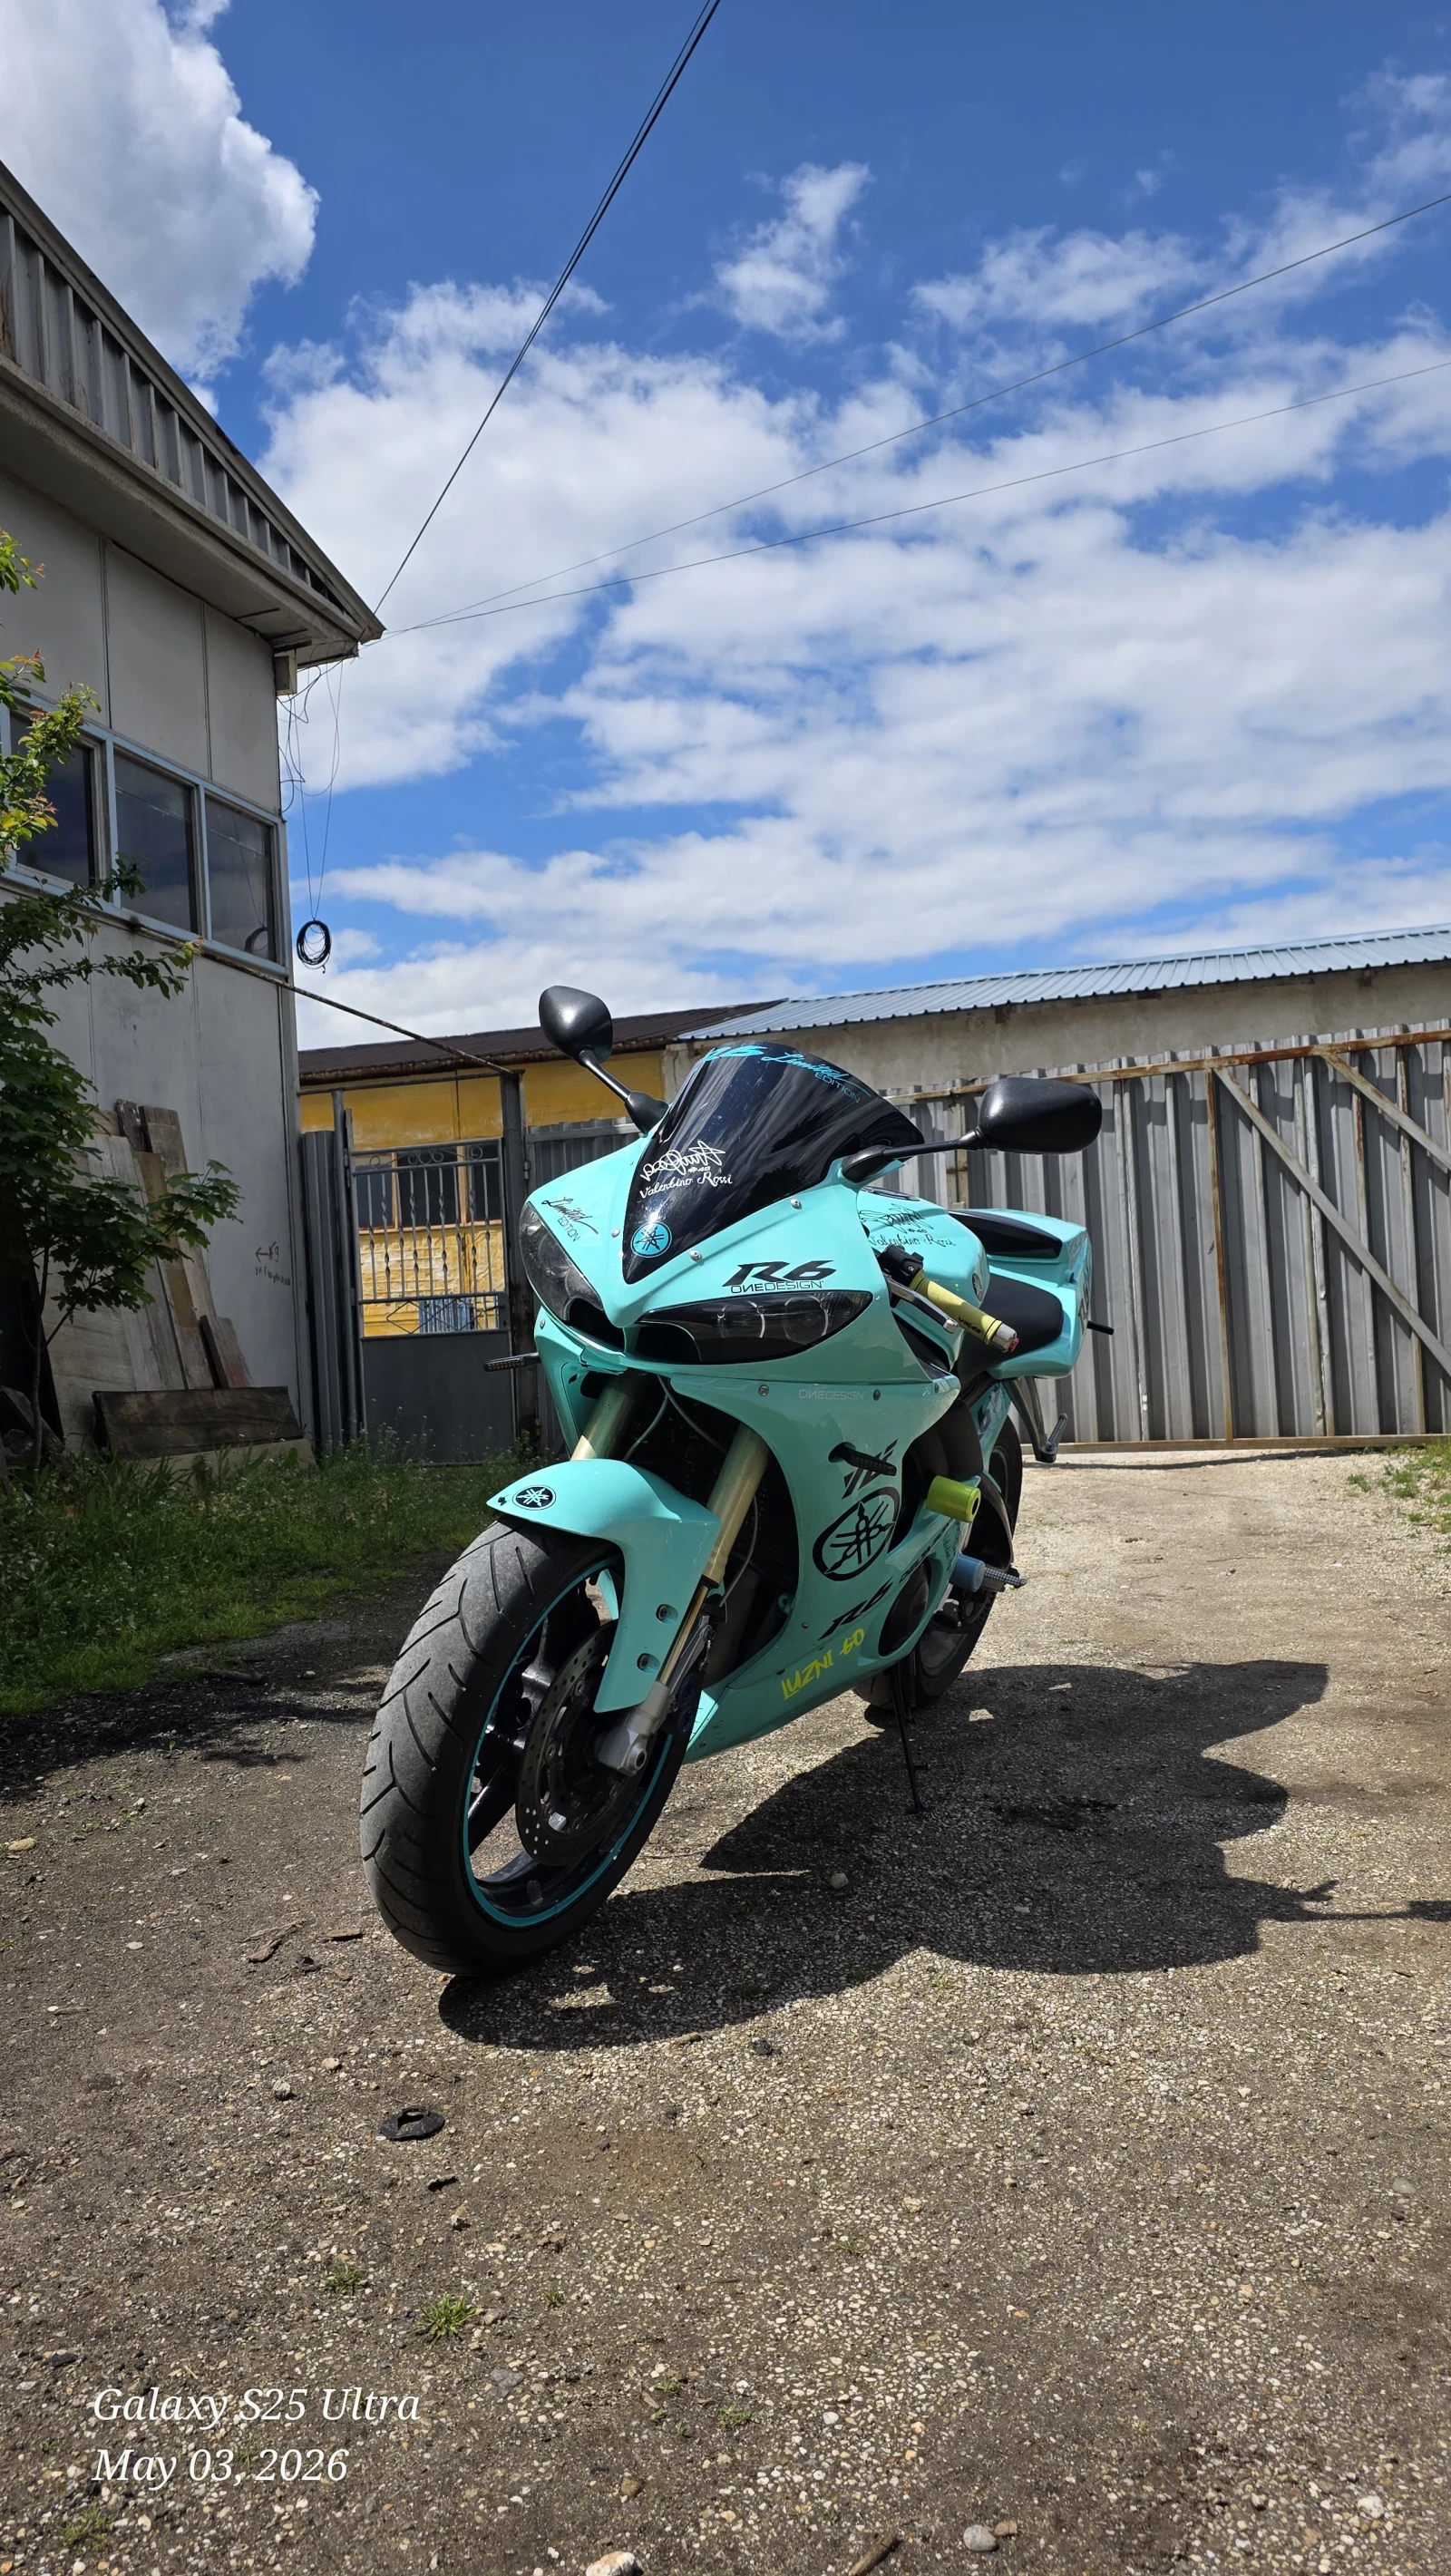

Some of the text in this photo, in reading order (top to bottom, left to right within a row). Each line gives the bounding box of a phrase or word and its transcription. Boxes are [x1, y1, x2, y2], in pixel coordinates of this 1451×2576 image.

[814, 1072, 861, 1103] EDITION
[639, 1171, 733, 1199] Valentino Rossi
[557, 1216, 581, 1242] EDITION
[722, 1259, 837, 1288] R6
[730, 1280, 823, 1294] ONEDESIGN
[798, 1389, 865, 1400] ONEDESIGN
[817, 1576, 894, 1641] R6
